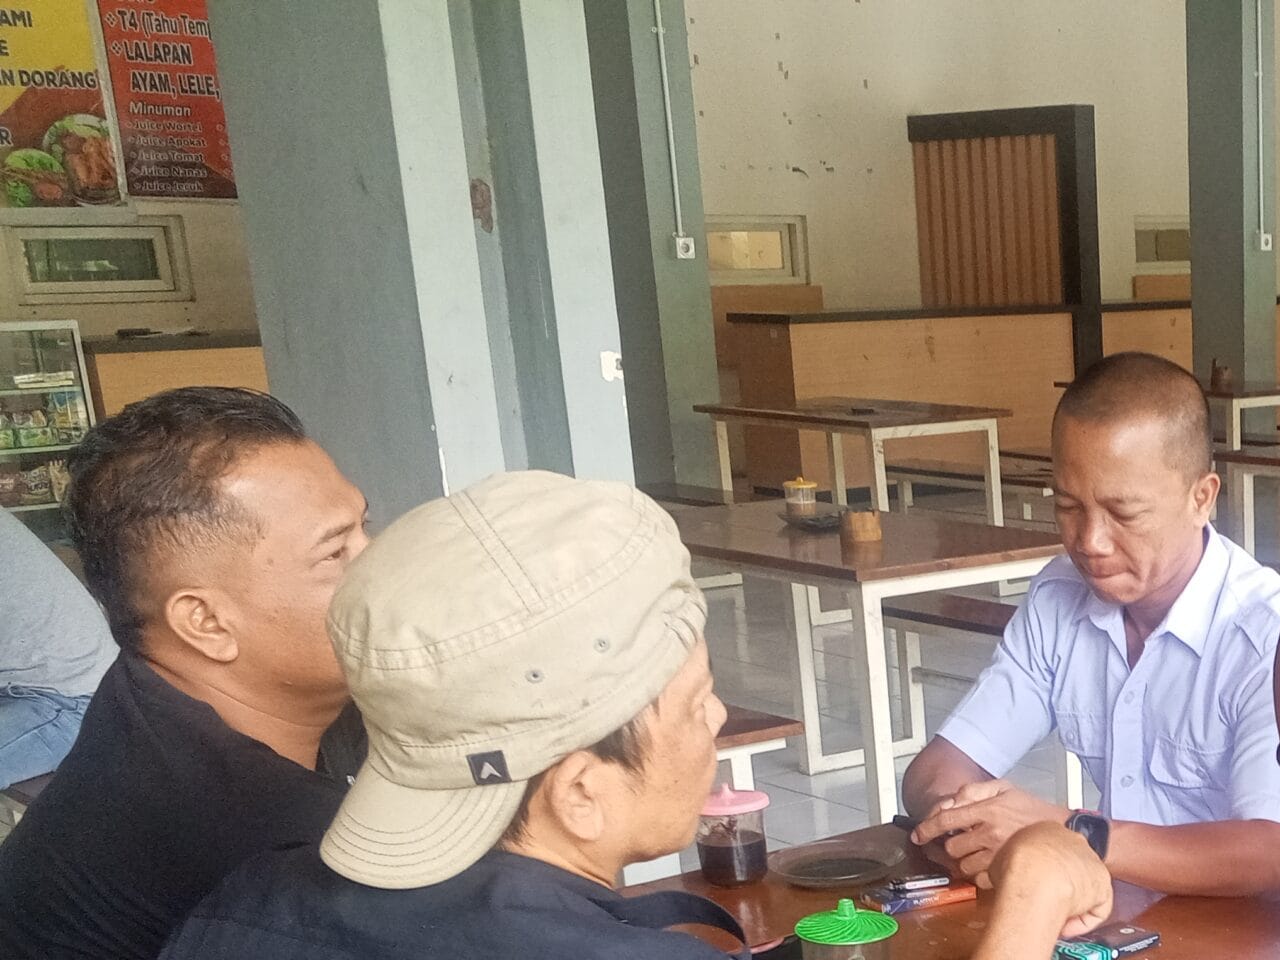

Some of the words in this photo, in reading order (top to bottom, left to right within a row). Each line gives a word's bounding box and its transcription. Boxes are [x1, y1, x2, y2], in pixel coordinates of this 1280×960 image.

[117, 9, 139, 31] T4
[123, 40, 193, 65] LALAPAN
[18, 69, 98, 89] DORANG
[130, 71, 177, 99] AYAM,
[129, 101, 192, 117] Minuman
